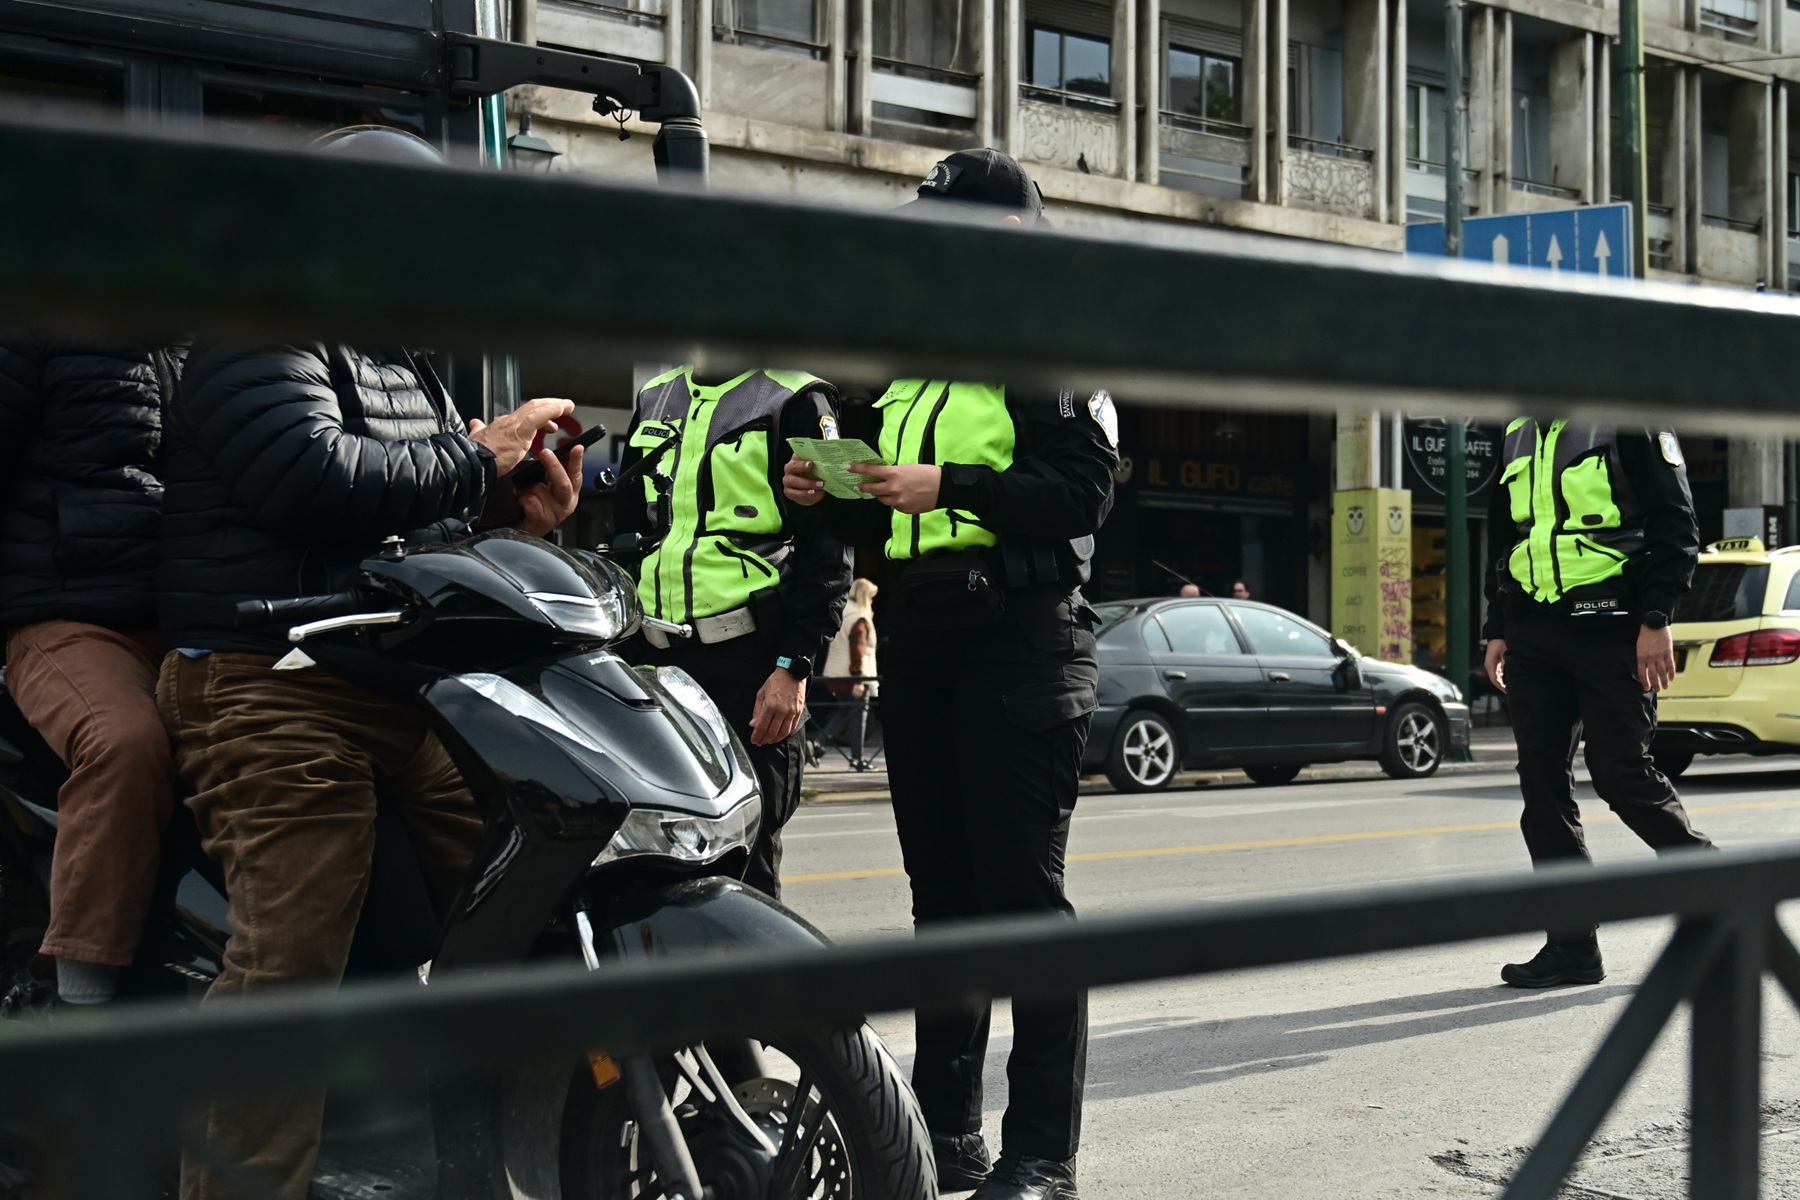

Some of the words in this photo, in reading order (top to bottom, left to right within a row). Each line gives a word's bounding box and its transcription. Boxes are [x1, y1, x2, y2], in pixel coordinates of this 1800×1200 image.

[1425, 436, 1447, 453] GUF
[1148, 458, 1169, 486] IL
[1180, 460, 1241, 491] GUFO
[1717, 540, 1749, 551] TAXI
[1575, 600, 1616, 609] POLICE
